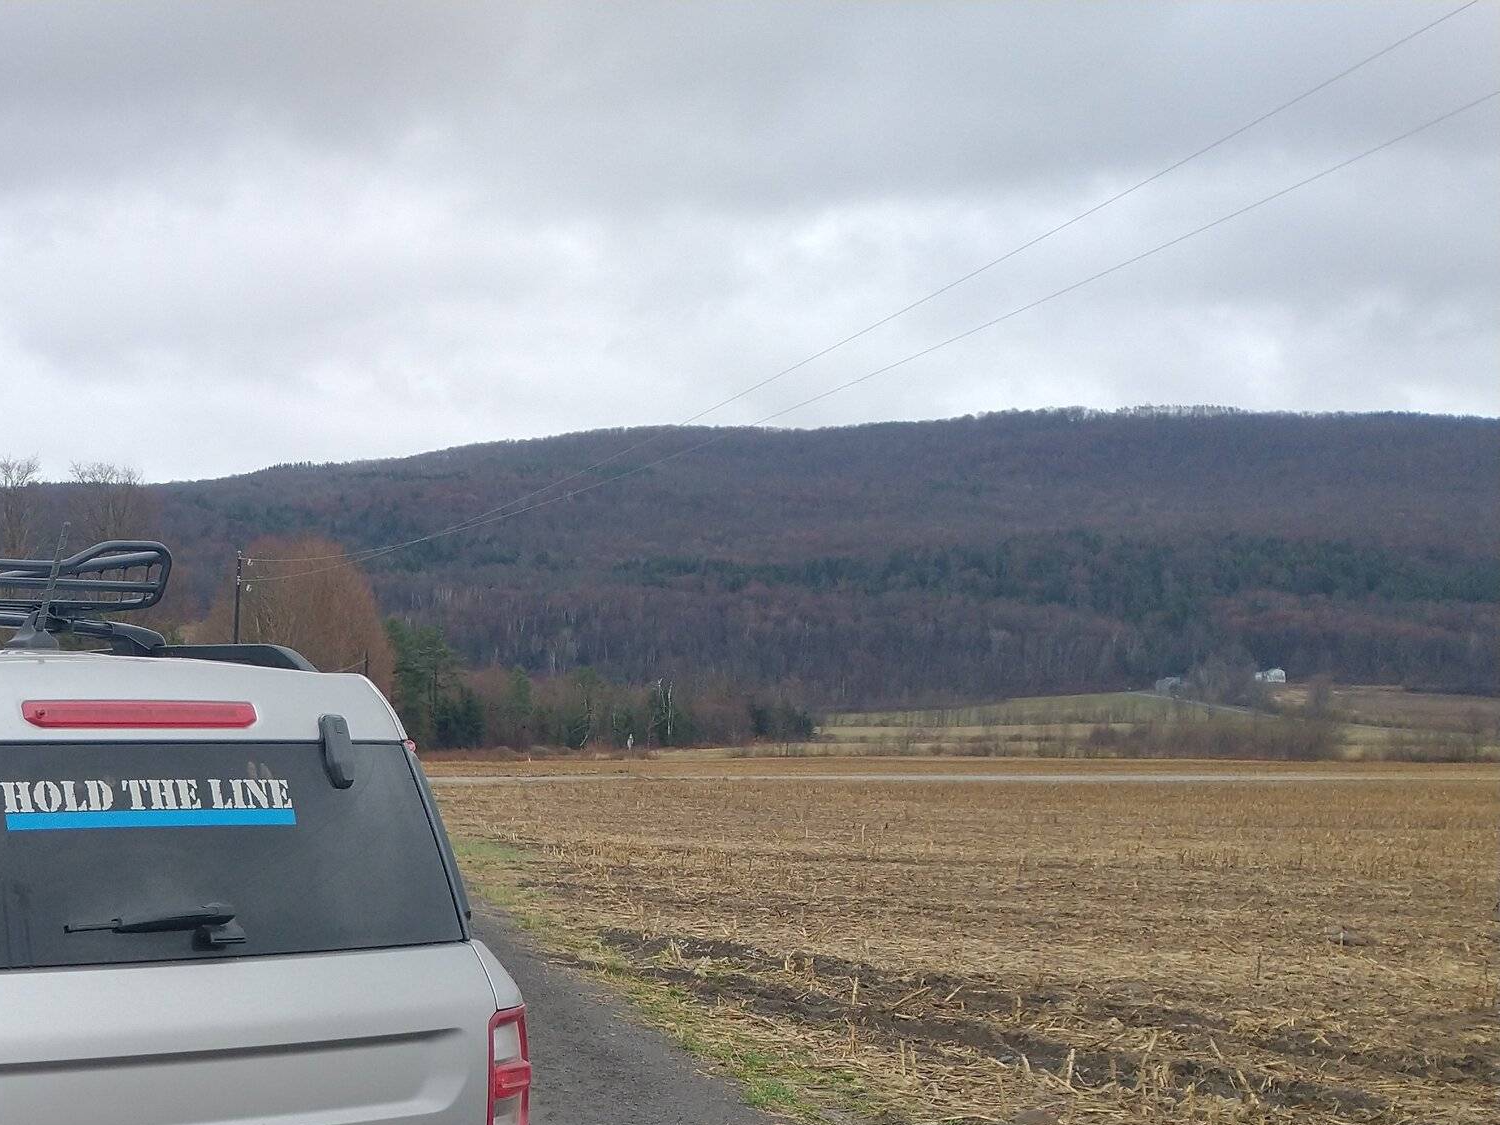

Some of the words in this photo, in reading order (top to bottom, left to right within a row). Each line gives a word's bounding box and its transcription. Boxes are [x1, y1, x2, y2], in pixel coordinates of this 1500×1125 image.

[0, 780, 114, 813] HOLD
[122, 779, 202, 810] THE
[207, 778, 293, 810] LINE
